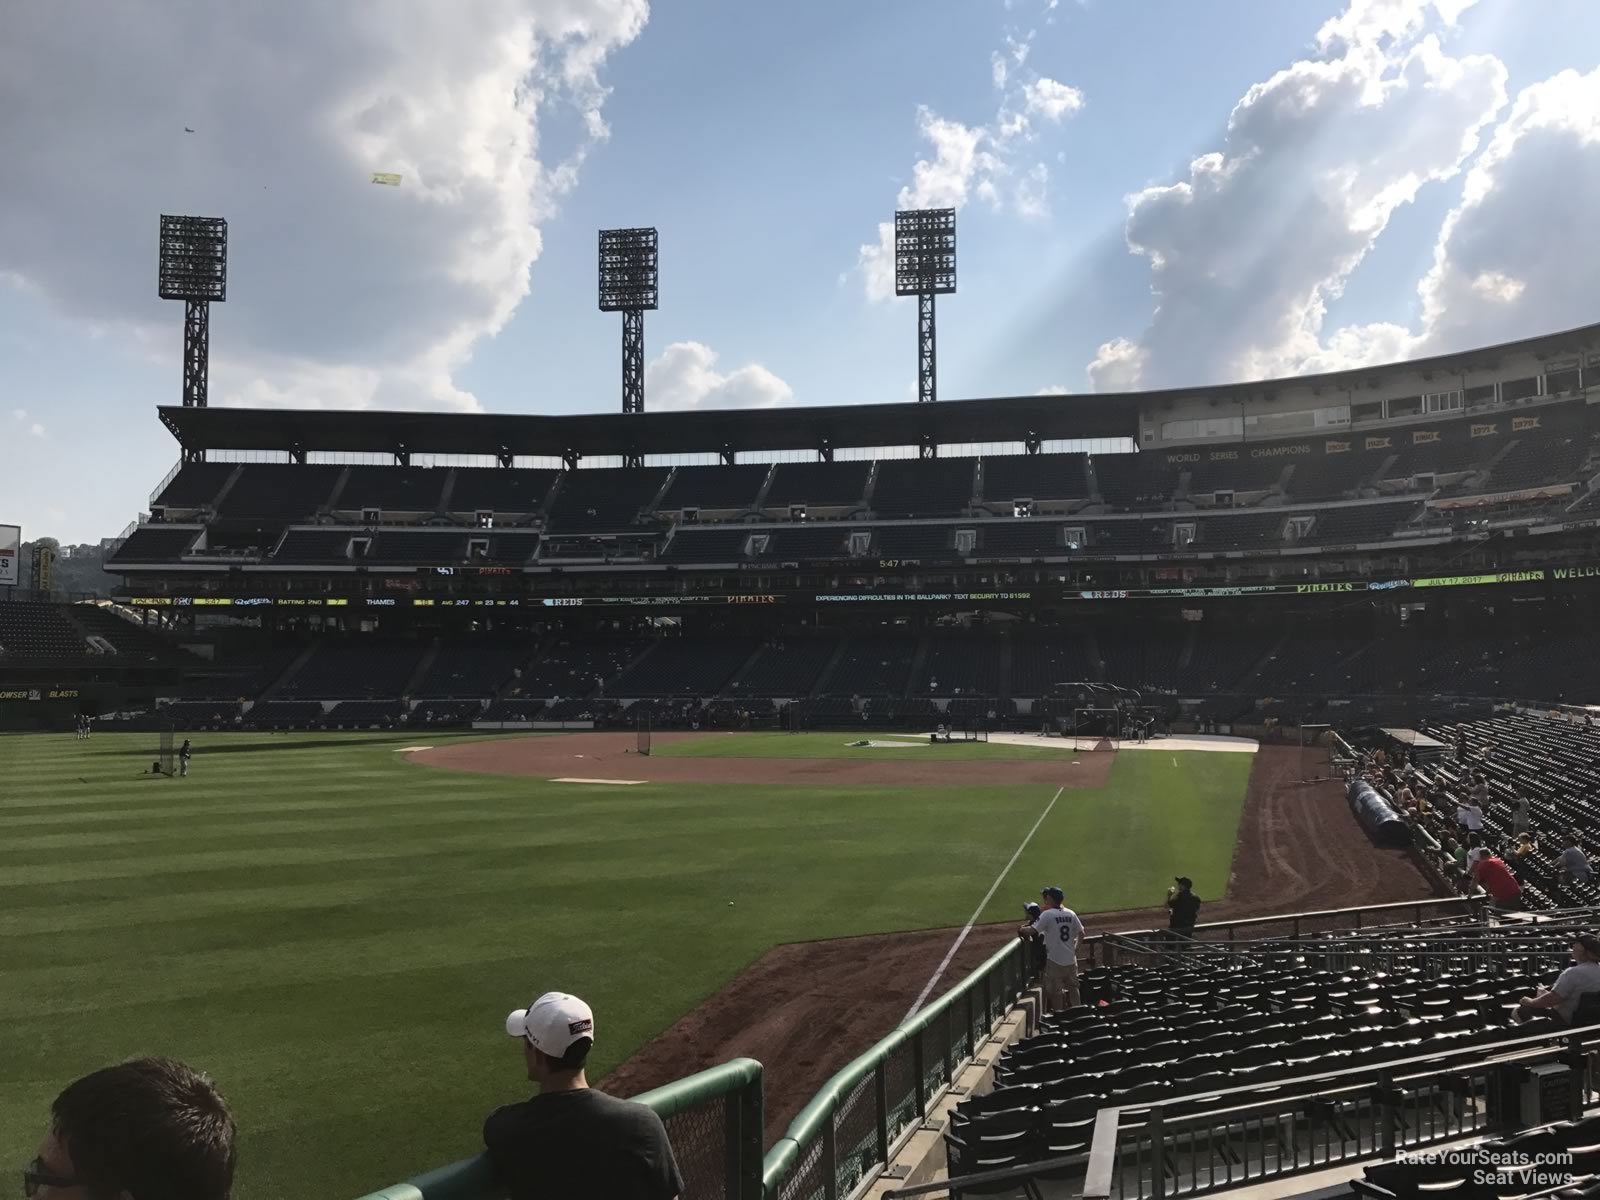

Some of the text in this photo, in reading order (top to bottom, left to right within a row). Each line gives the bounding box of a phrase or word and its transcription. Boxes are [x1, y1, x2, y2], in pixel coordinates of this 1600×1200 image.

[1167, 445, 1311, 464] WORLD SERIES CHAMPIONS
[880, 560, 899, 568] 5:47
[1297, 583, 1353, 593] PIRATES
[1095, 590, 1127, 599] REDS
[555, 598, 583, 606] REDS
[727, 595, 775, 604] PIRATES
[49, 690, 79, 698] BLASTS
[1060, 925, 1069, 942] 8
